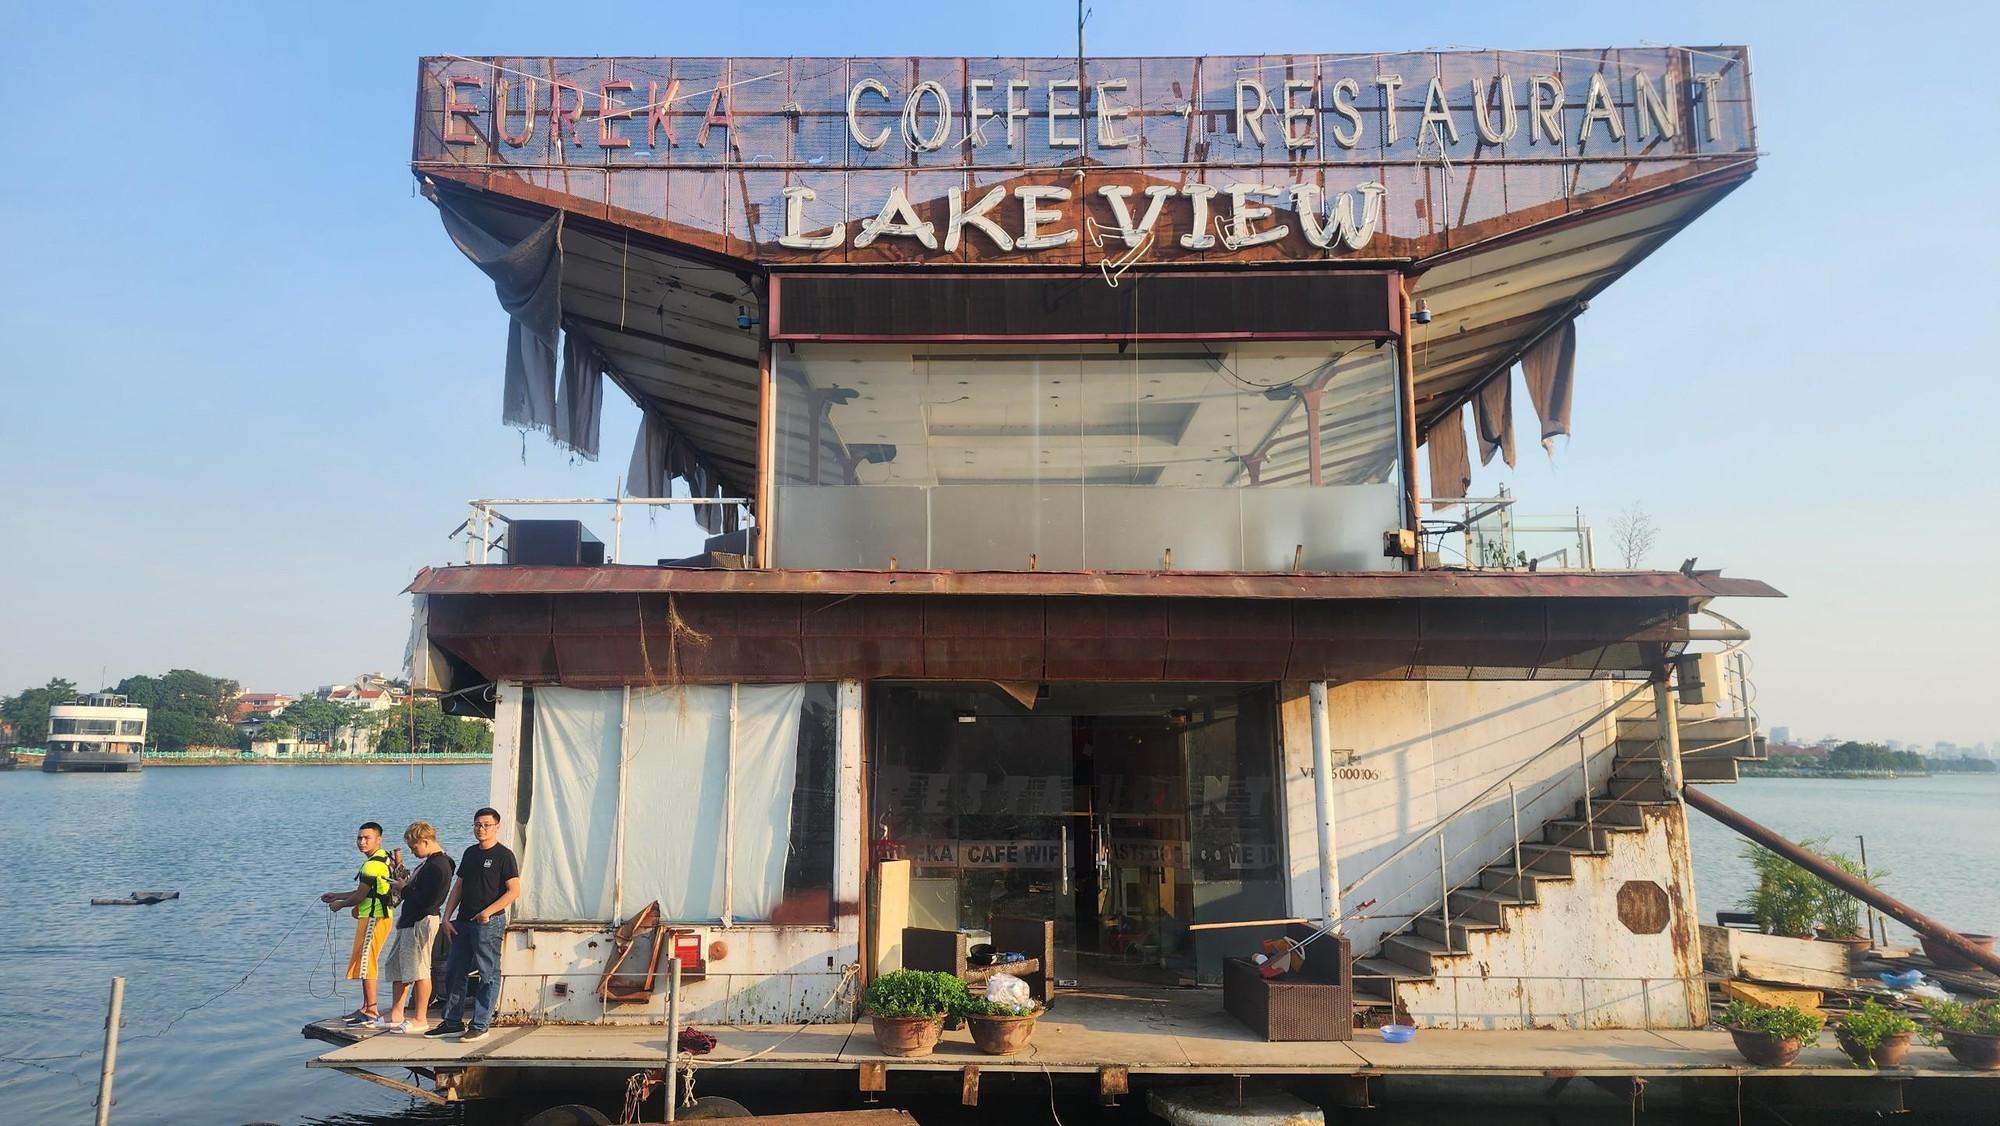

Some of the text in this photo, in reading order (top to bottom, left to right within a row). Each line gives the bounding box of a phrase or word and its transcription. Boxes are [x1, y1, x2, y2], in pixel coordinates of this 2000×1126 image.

[444, 73, 1724, 152] EUREKA COFFEE RESTAURANT
[778, 181, 1388, 253] LAKE VIEW
[967, 841, 1017, 863] CAFÉ
